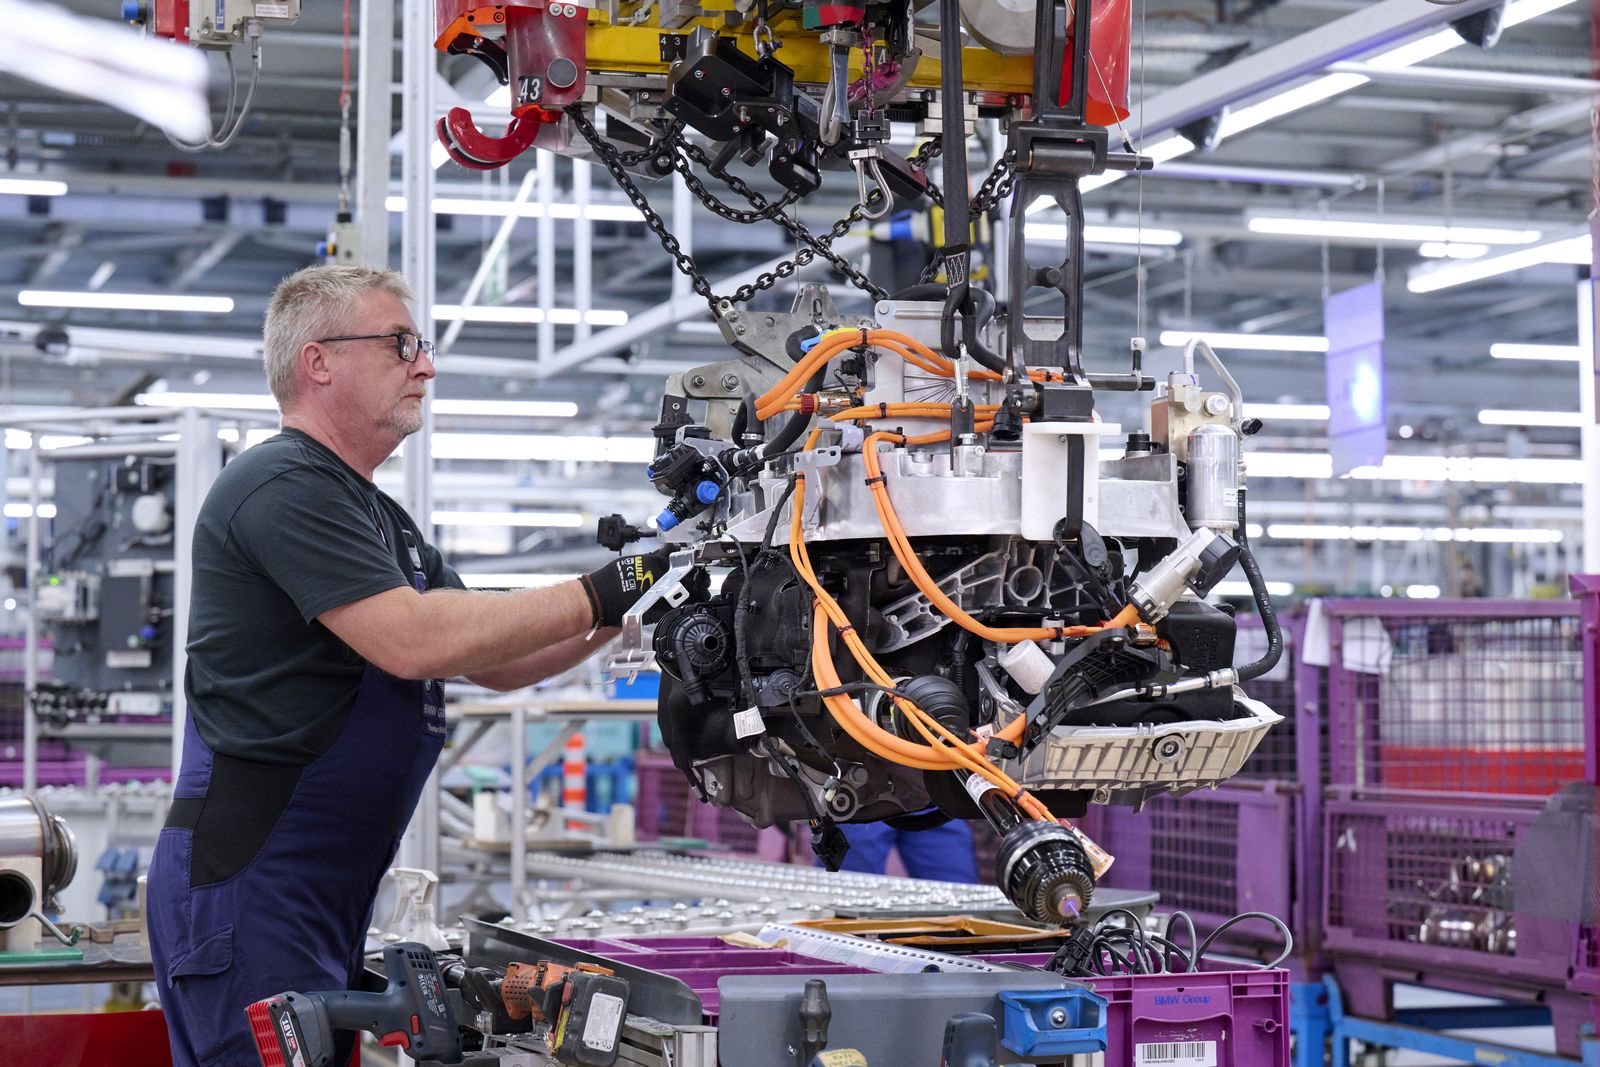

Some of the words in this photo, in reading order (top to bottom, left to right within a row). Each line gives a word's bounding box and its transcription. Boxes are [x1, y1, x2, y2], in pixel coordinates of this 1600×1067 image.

[520, 78, 541, 101] 43
[1154, 995, 1180, 1006] BMW
[1182, 994, 1211, 1005] Group
[281, 1019, 294, 1037] 18V
